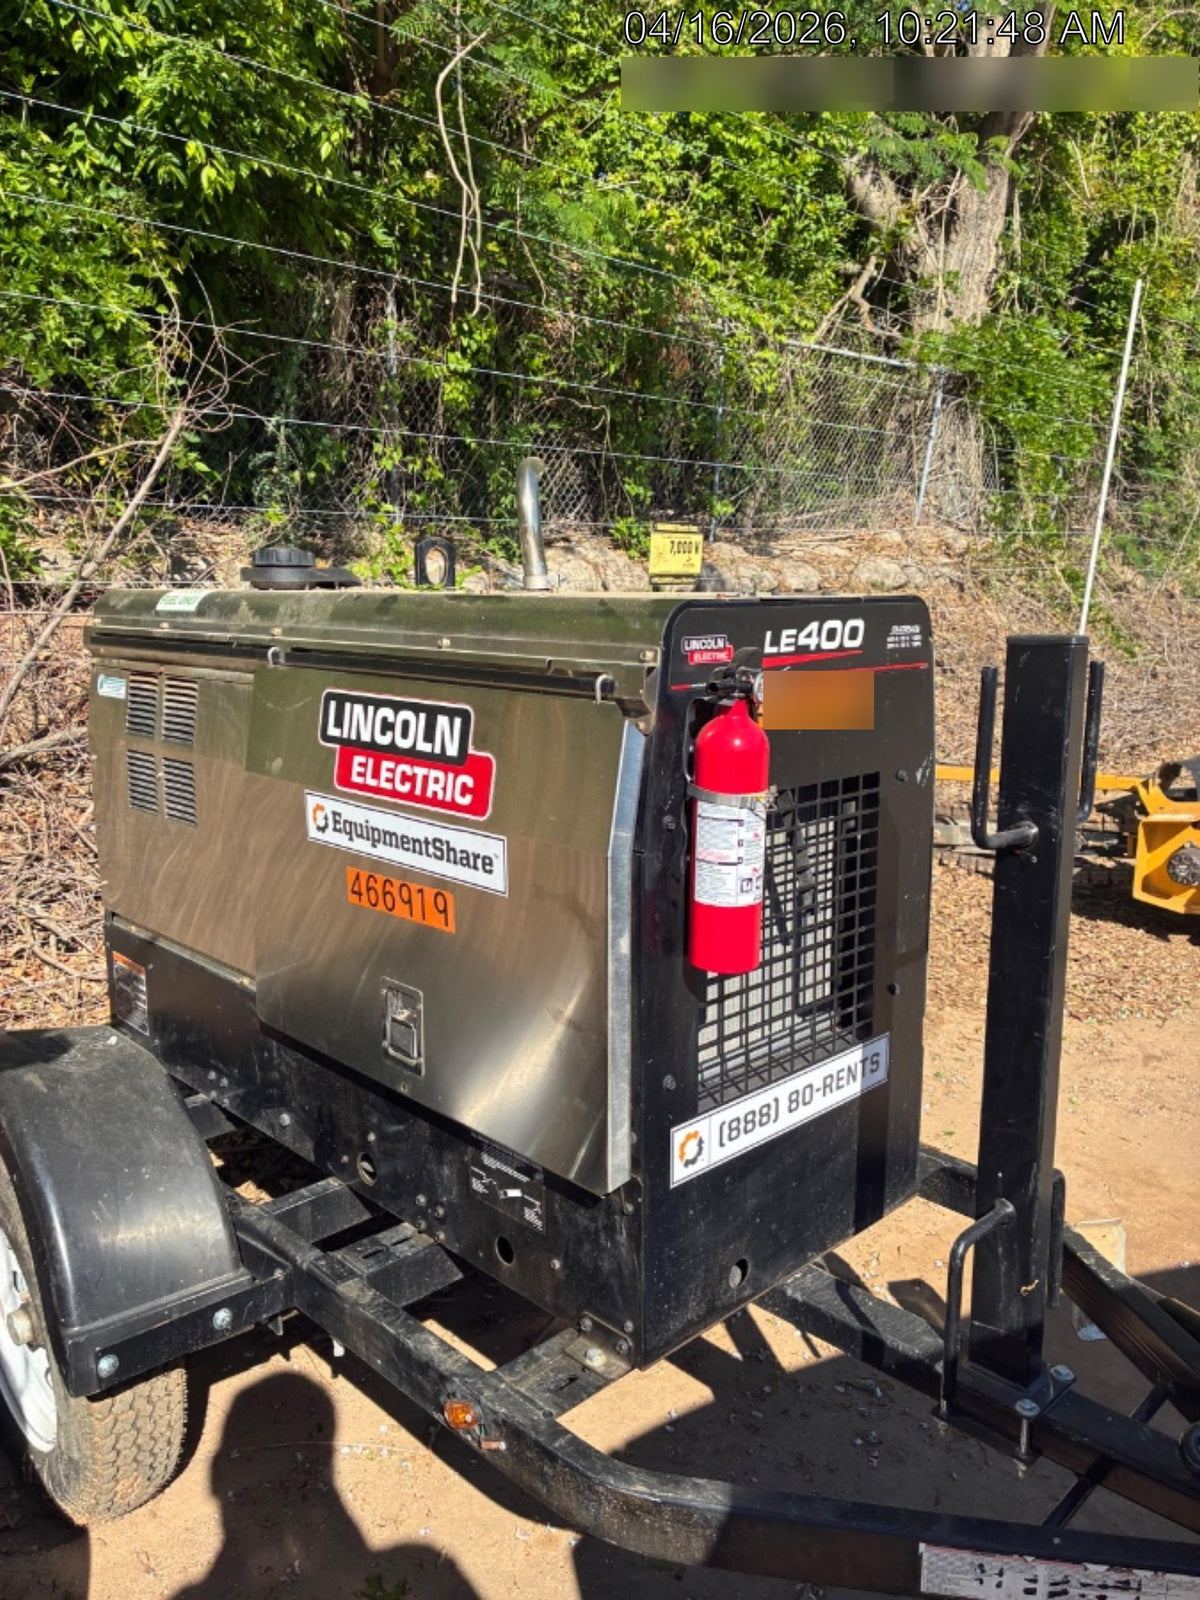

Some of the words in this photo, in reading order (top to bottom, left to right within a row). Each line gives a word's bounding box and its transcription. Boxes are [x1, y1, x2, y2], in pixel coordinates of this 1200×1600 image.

[684, 637, 726, 652] LINCOLN
[764, 618, 865, 654] LE400
[326, 700, 463, 757] LINCOLN
[350, 755, 475, 806] ELECTRIC
[331, 810, 494, 874] EquipmentShare
[350, 871, 449, 927] 466919
[718, 1096, 780, 1148] (888)
[787, 1051, 881, 1114] 80-RENTS
